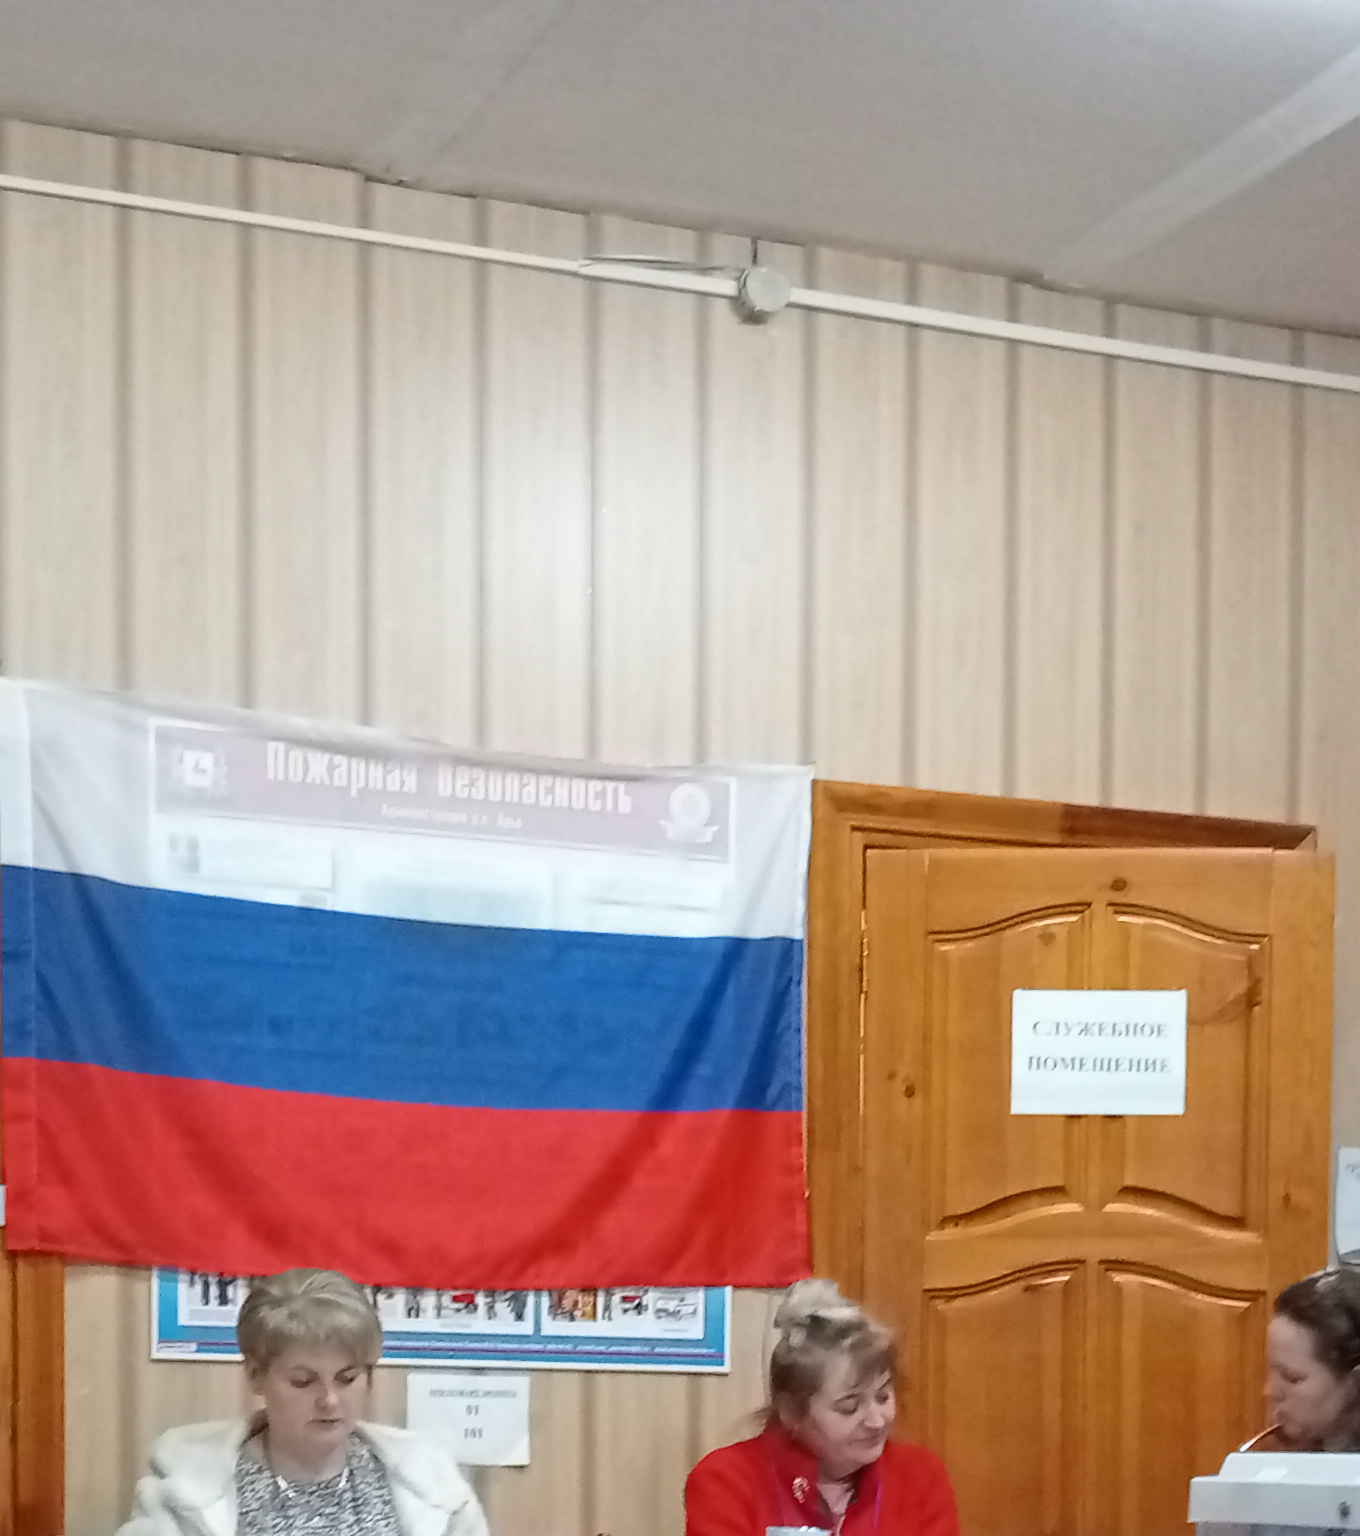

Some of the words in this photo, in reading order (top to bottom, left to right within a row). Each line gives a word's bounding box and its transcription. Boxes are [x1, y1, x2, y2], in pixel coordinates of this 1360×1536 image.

[265, 740, 418, 798] Пожарная
[1031, 1021, 1168, 1037] СЛУЖЕБНОЕ
[1027, 1056, 1171, 1073] ПОМЕЩЕНИЕ
[464, 1427, 482, 1438] 101
